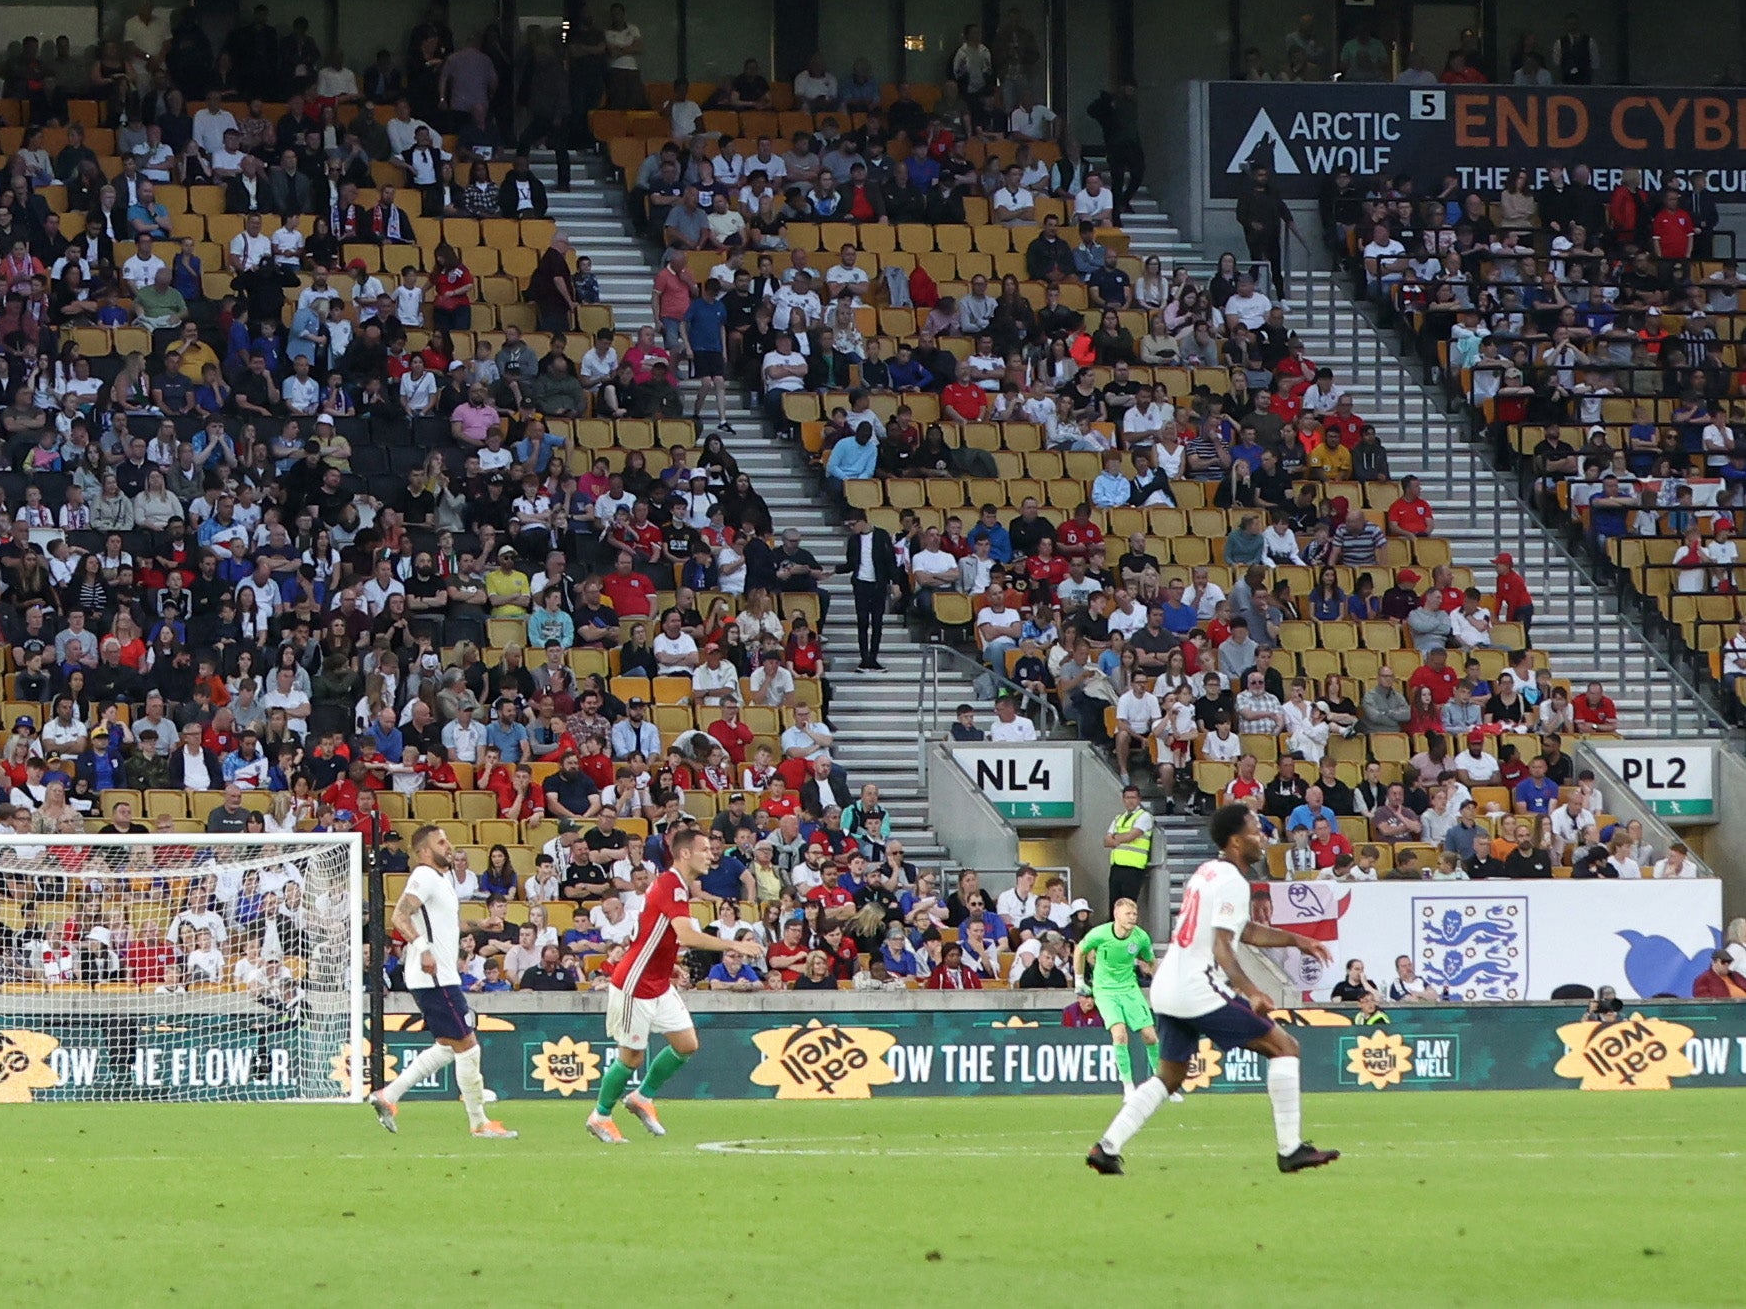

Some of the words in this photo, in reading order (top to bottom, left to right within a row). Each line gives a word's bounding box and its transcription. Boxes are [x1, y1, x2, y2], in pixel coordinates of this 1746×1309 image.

[1421, 93, 1436, 117] 5
[1289, 111, 1402, 142] ARCTIC
[1455, 94, 1590, 149] END
[1610, 96, 1746, 151] CYB
[1304, 145, 1392, 175] WOLF
[1456, 166, 1511, 190] THE
[1638, 168, 1663, 192] IN
[977, 758, 1051, 791] NL4
[1622, 757, 1687, 789] PL2
[548, 1050, 578, 1065] eat
[1363, 1044, 1391, 1059] eat
[1416, 1040, 1451, 1059] PLAY
[548, 1062, 584, 1077] well
[941, 1045, 996, 1083] THE
[1225, 1063, 1262, 1082] WELL
[1363, 1054, 1397, 1070] well
[1415, 1058, 1452, 1077] WELL
